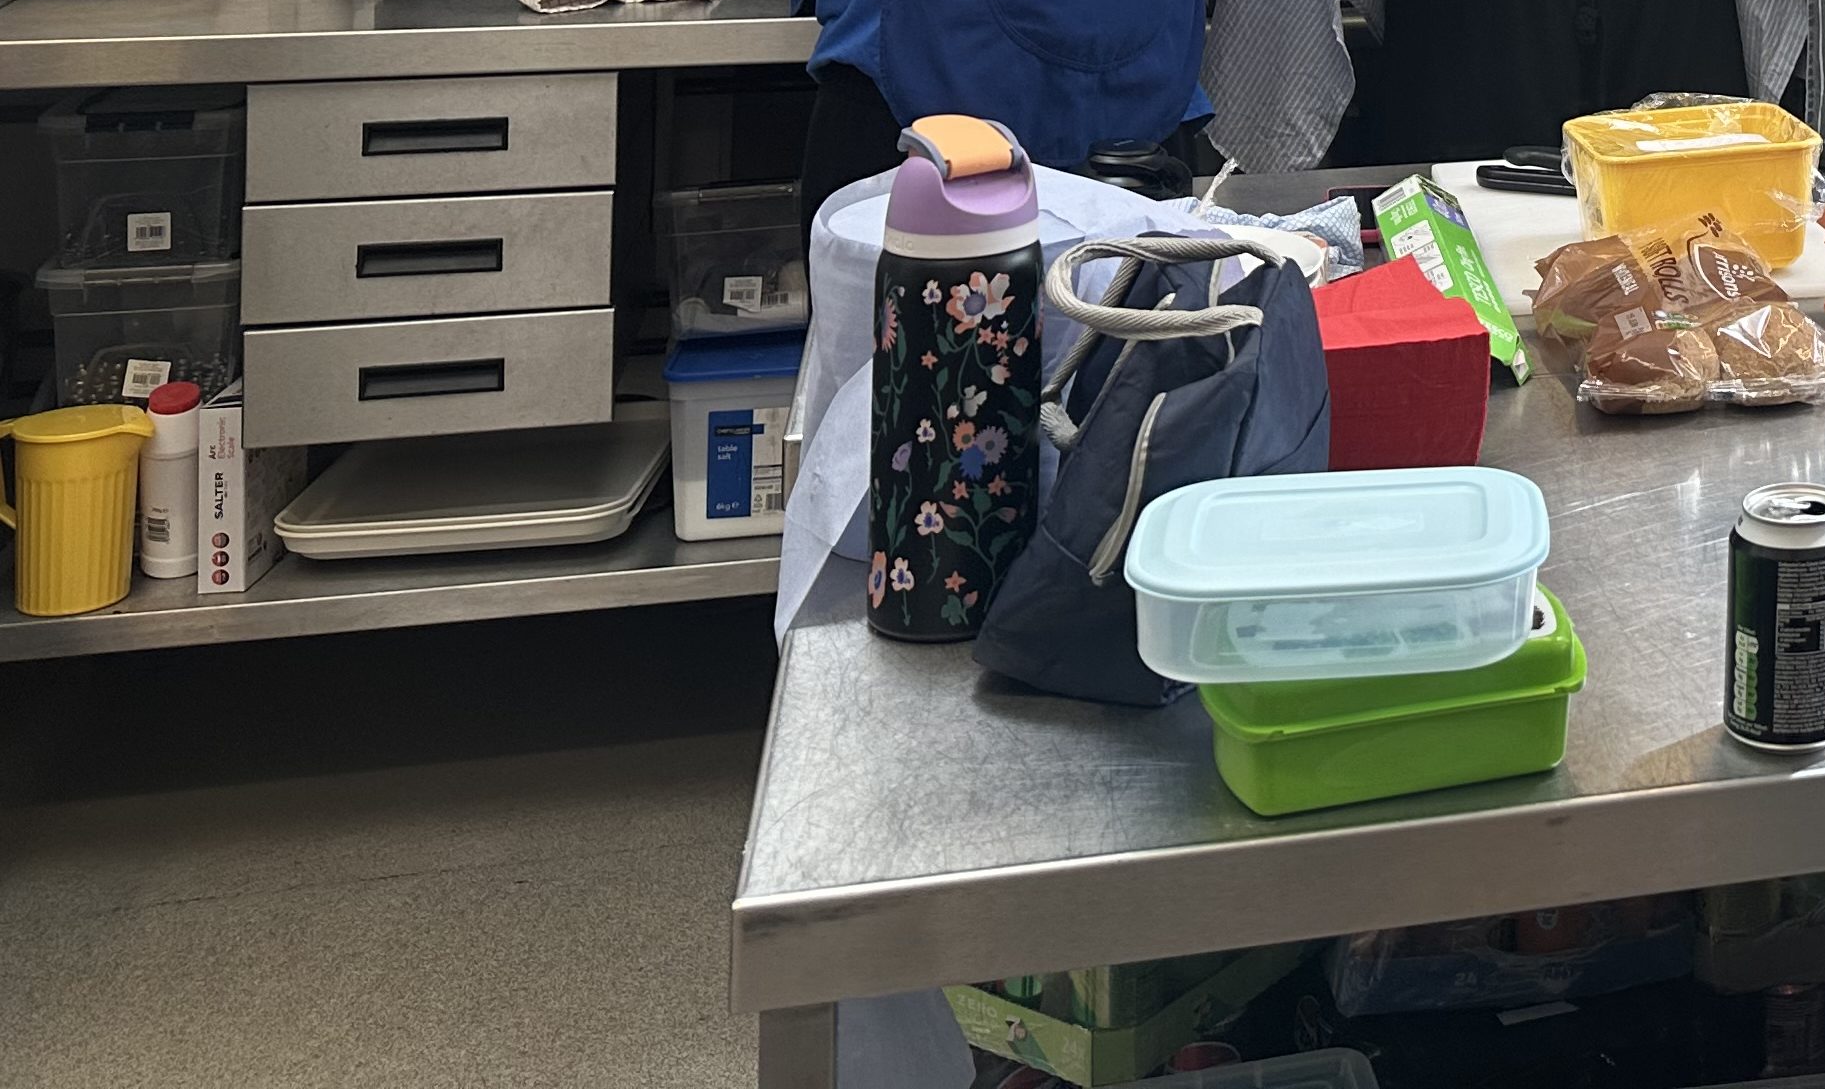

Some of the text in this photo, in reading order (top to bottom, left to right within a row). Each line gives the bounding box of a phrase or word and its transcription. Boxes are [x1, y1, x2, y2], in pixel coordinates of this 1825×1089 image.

[717, 444, 738, 453] table
[717, 453, 731, 461] salt
[215, 472, 224, 520] SALTER
